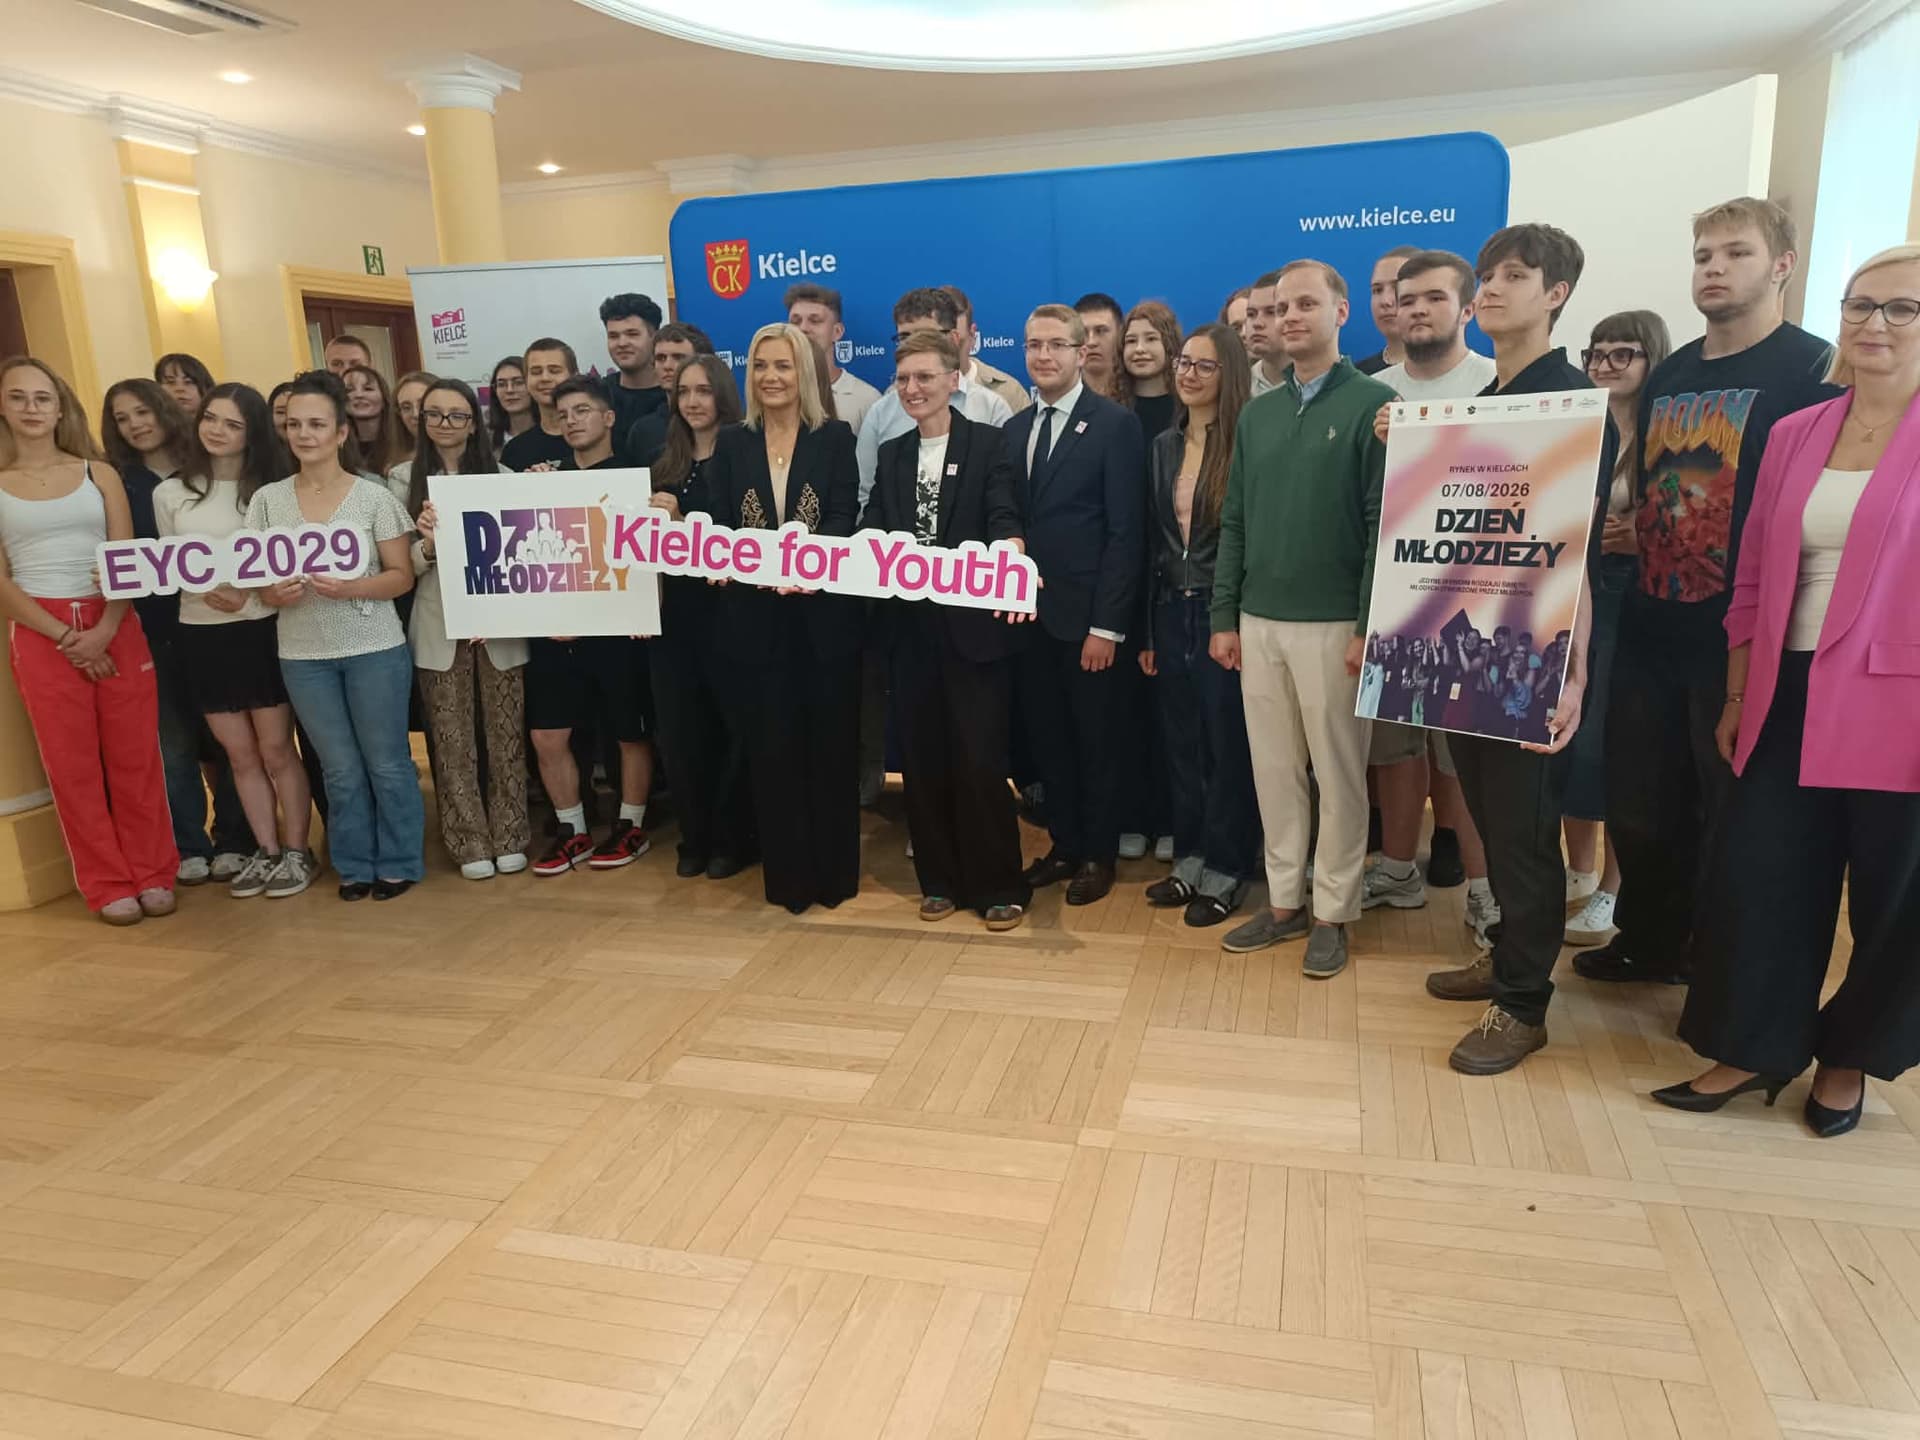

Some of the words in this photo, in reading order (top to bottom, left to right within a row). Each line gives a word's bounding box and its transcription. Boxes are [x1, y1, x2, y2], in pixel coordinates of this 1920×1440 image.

[1299, 205, 1456, 232] www.kielce.eu
[712, 264, 743, 293] CK
[758, 249, 837, 279] Kielce
[433, 323, 467, 344] KIELCE
[983, 337, 1015, 348] Kielce
[855, 345, 885, 356] Kielce
[1644, 389, 1760, 470] DOOM
[1486, 464, 1529, 473] KIELCACH
[1441, 482, 1530, 498] 07/08/2026
[1435, 502, 1525, 534] DZIEŃ
[104, 541, 215, 591] EYC
[233, 528, 360, 580] 2029
[613, 514, 762, 574] Kielce
[779, 530, 850, 582] for
[868, 538, 1029, 601] Youth
[1394, 535, 1567, 569] MŁODZIEŻY
